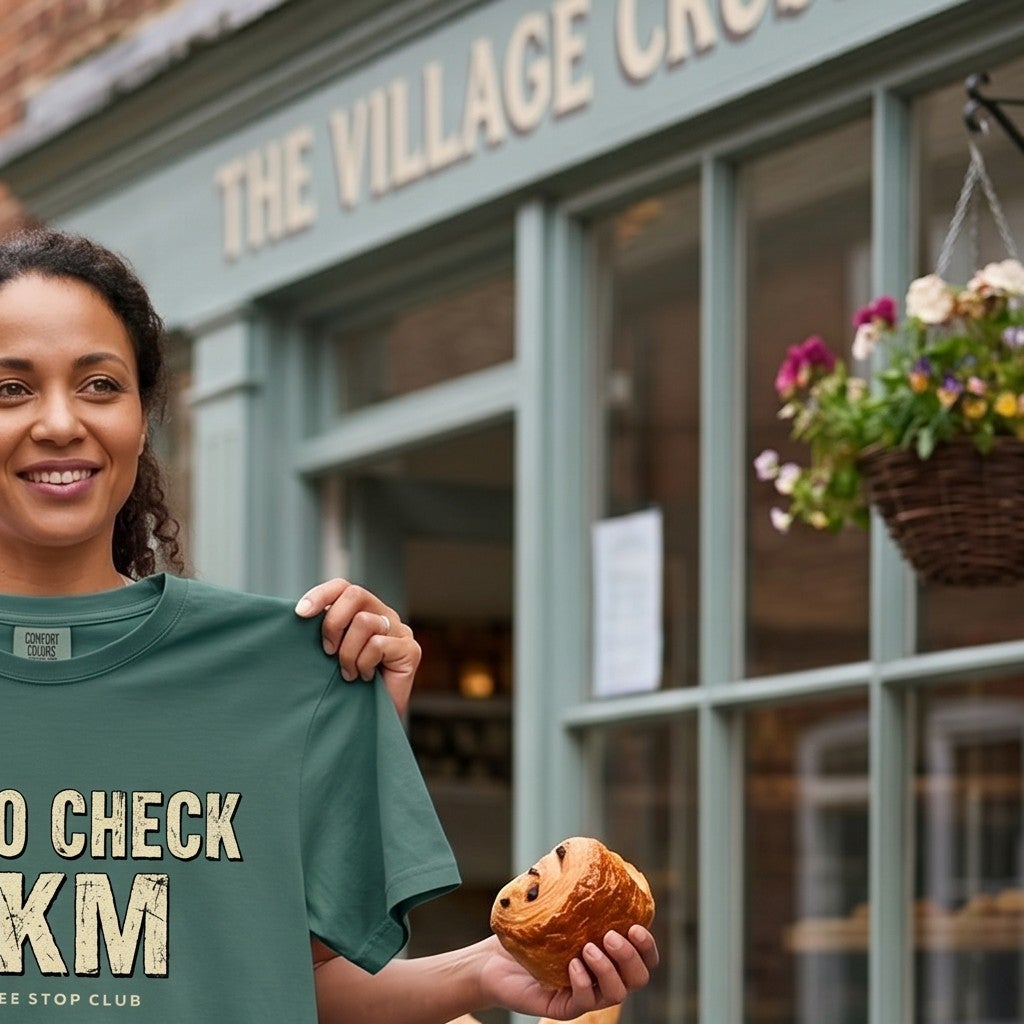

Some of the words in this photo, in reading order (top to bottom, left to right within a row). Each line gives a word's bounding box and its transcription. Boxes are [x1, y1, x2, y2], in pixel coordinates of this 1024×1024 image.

[215, 127, 317, 264] THE
[329, 0, 594, 211] VILLAGE
[51, 788, 244, 862] CHECK
[28, 992, 81, 1006] STOP
[89, 993, 142, 1008] CLUB
